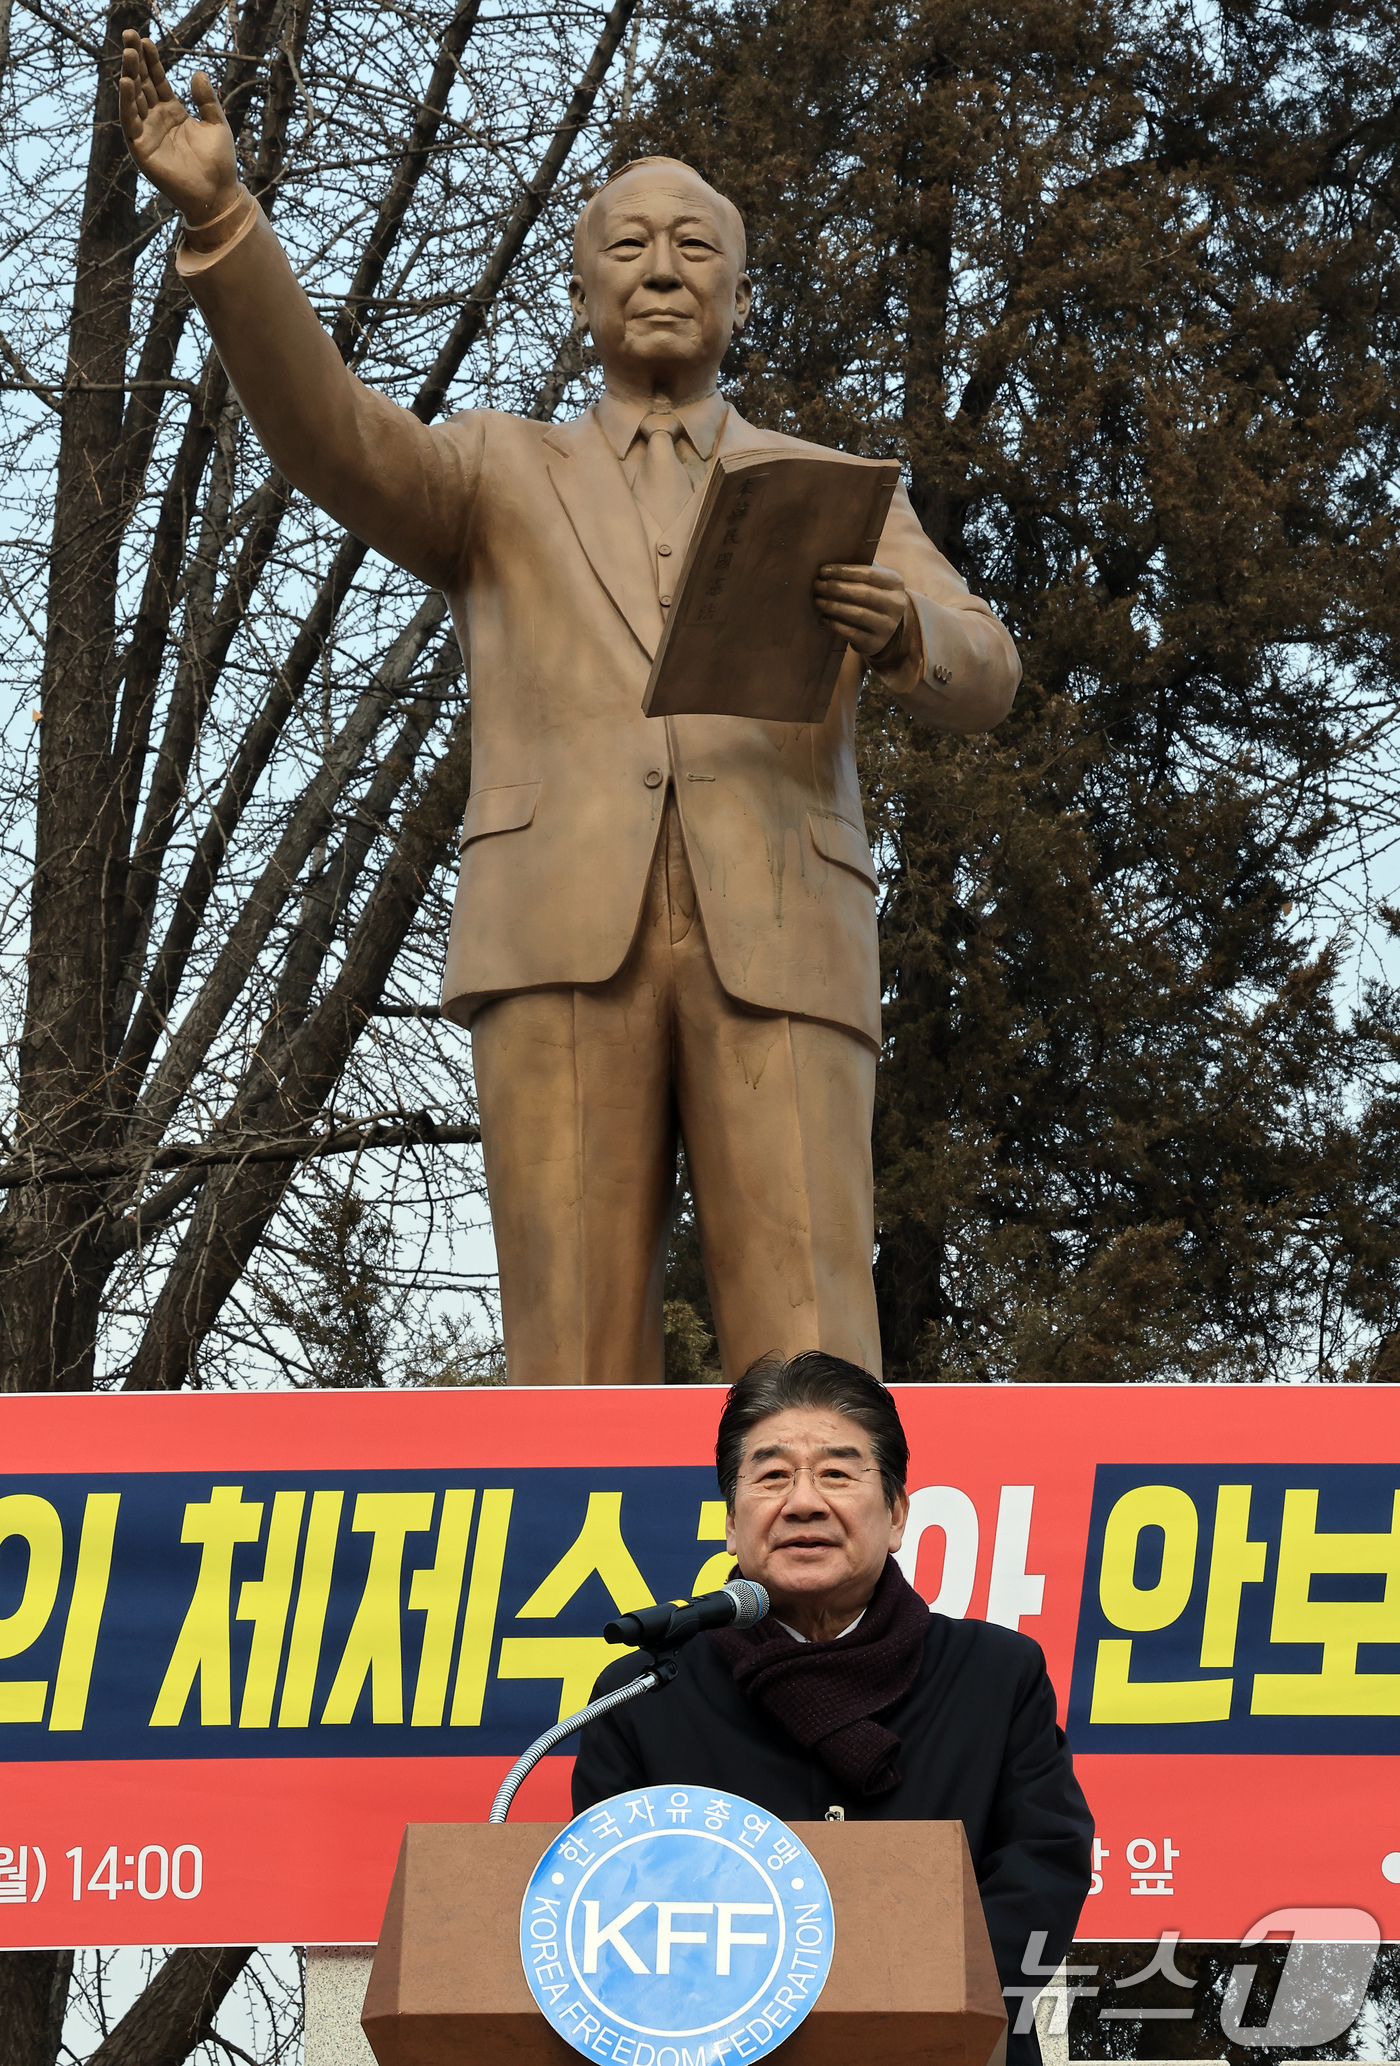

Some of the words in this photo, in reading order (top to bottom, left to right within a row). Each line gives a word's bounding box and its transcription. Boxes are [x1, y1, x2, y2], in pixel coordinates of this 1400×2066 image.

[1089, 1484, 1400, 1724] 안보
[557, 1792, 802, 1871] 한국자유총연맹
[1126, 1838, 1180, 1895] 앞
[65, 1844, 203, 1901] 14:00
[581, 1900, 774, 1976] KFF
[530, 1896, 570, 2006] KOREA
[558, 2000, 707, 2066] FREEDOM
[712, 1902, 822, 2066] FEDERATION
